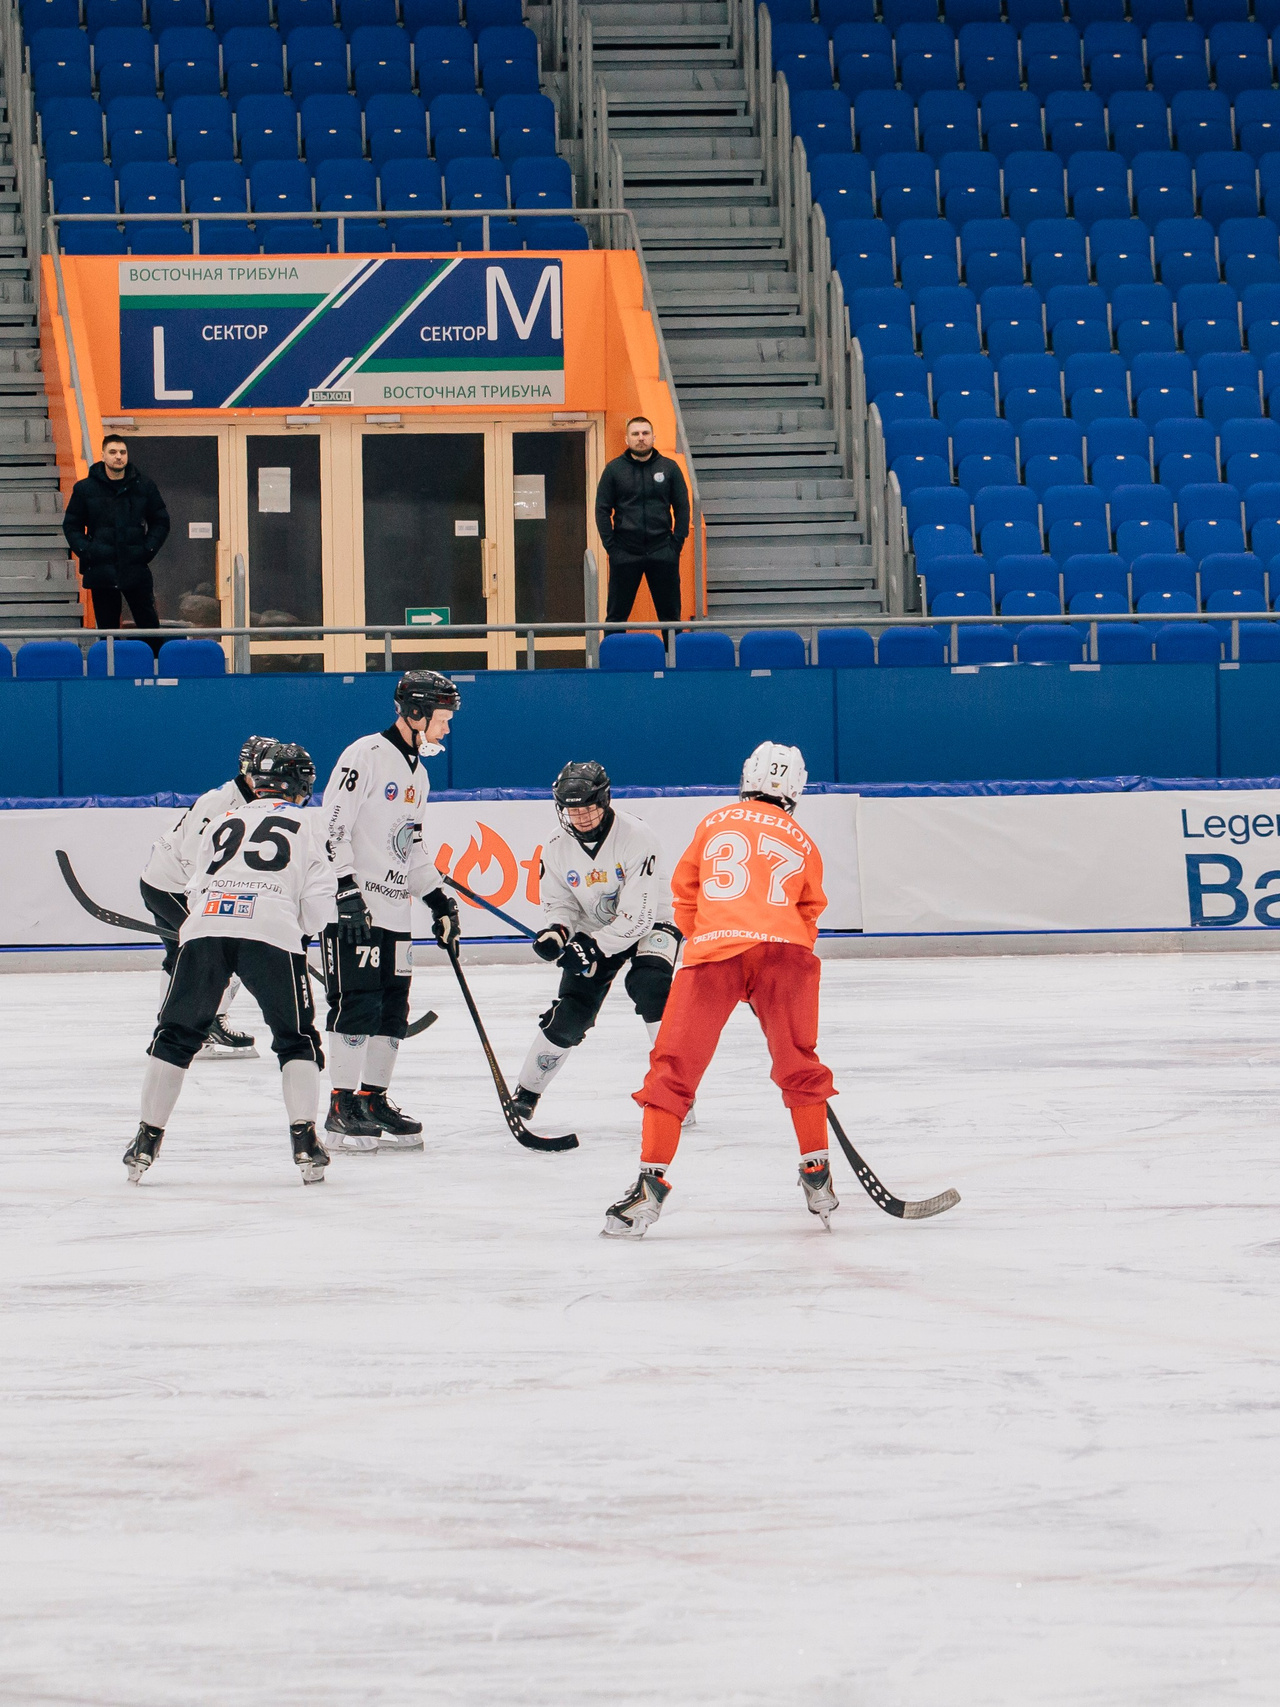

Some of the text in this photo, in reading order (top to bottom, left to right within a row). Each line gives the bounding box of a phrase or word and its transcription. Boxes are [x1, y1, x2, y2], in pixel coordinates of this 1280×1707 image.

[129, 267, 299, 281] ВОСТОЧНАЯ ТРИБУНА
[202, 325, 268, 341] СЕКТОР
[420, 326, 486, 341] СЕКТОР
[153, 326, 193, 400] L
[313, 391, 351, 401] ВЫХОД
[383, 384, 552, 399] ВОСТОЧНАЯ ТРИБУНА
[769, 762, 789, 778] 37
[338, 766, 359, 792] 78
[205, 815, 302, 876] 95
[703, 830, 806, 907] 37
[211, 879, 283, 895] ПОЛИМЕТАЛЛ
[355, 945, 380, 968] 78
